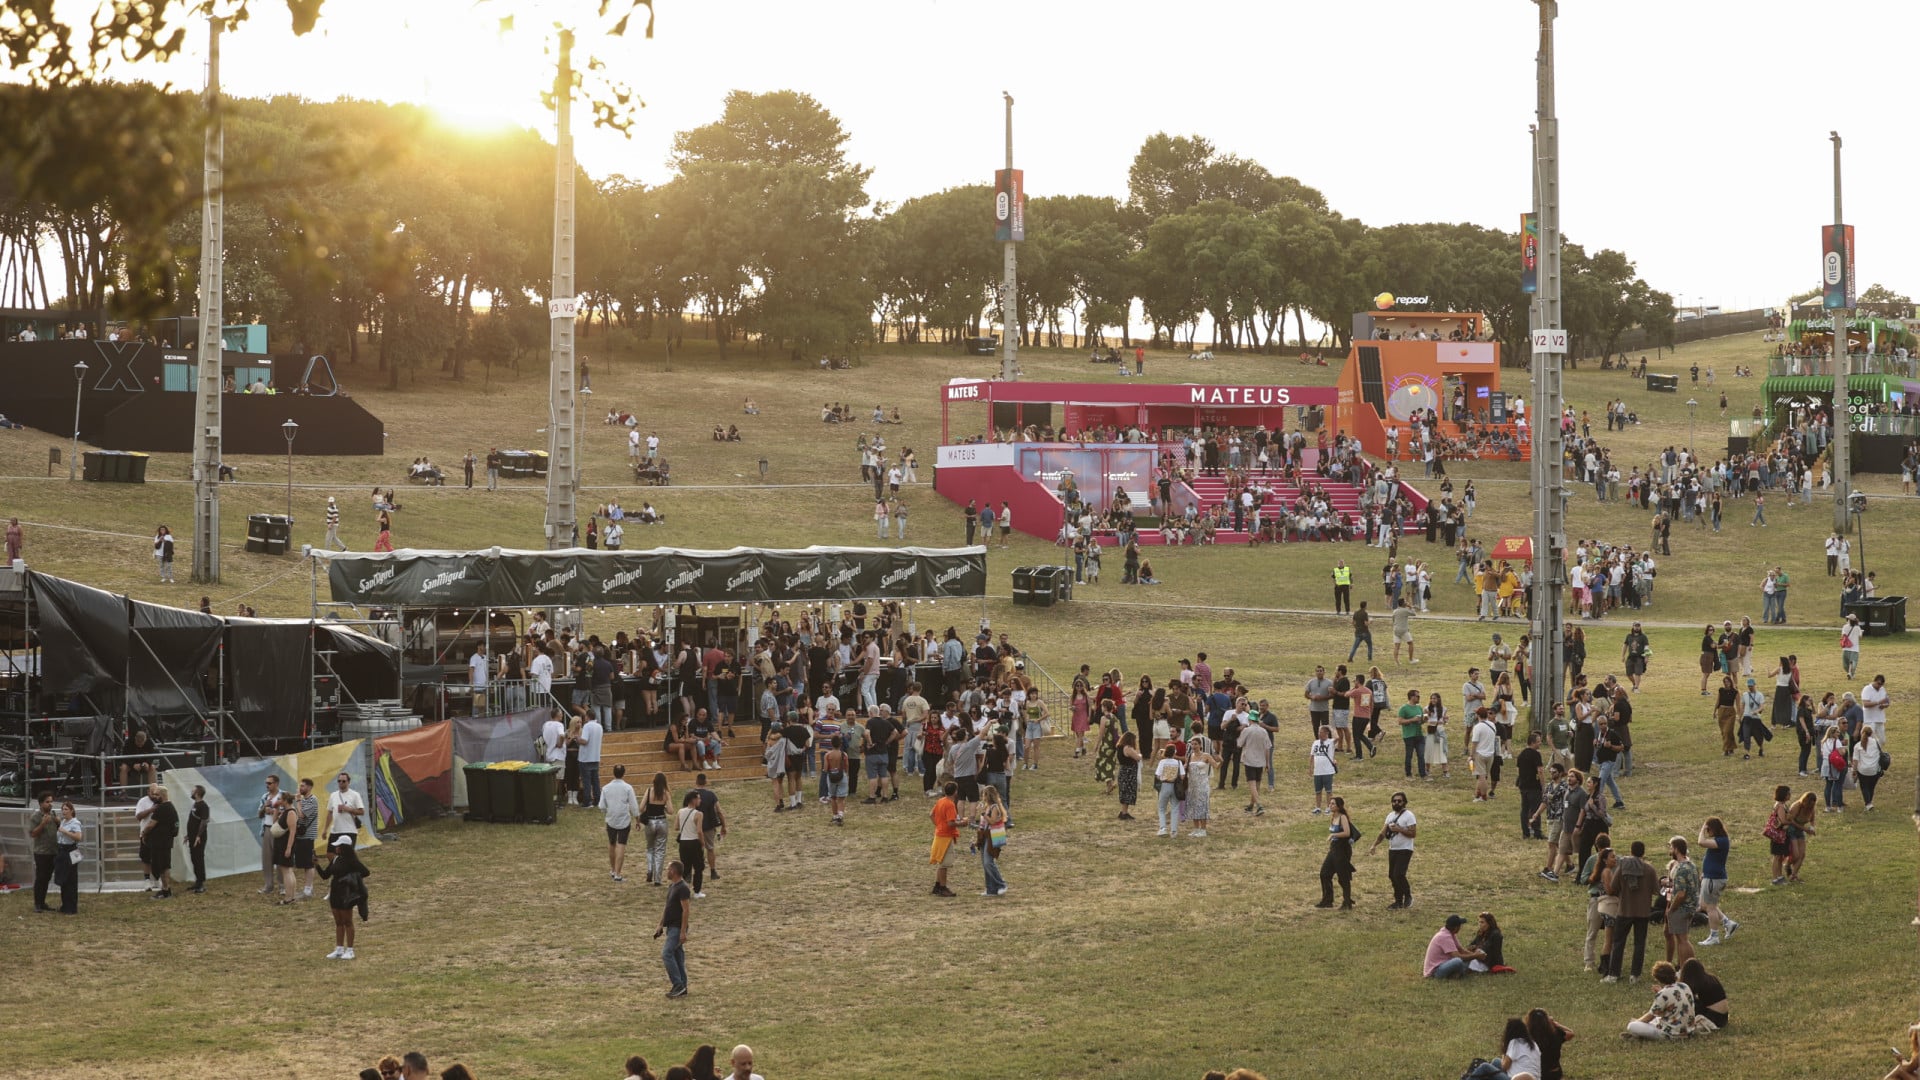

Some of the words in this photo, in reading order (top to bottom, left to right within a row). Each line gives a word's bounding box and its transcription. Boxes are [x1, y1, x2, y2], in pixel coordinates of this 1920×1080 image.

[1829, 256, 1837, 280] MEO
[1396, 296, 1428, 305] repsol
[564, 304, 574, 312] V3
[1534, 335, 1546, 346] V2
[1552, 335, 1564, 346] V2
[947, 384, 979, 400] MATEUS
[1190, 387, 1291, 405] MATEUS
[947, 449, 976, 462] MATEUS
